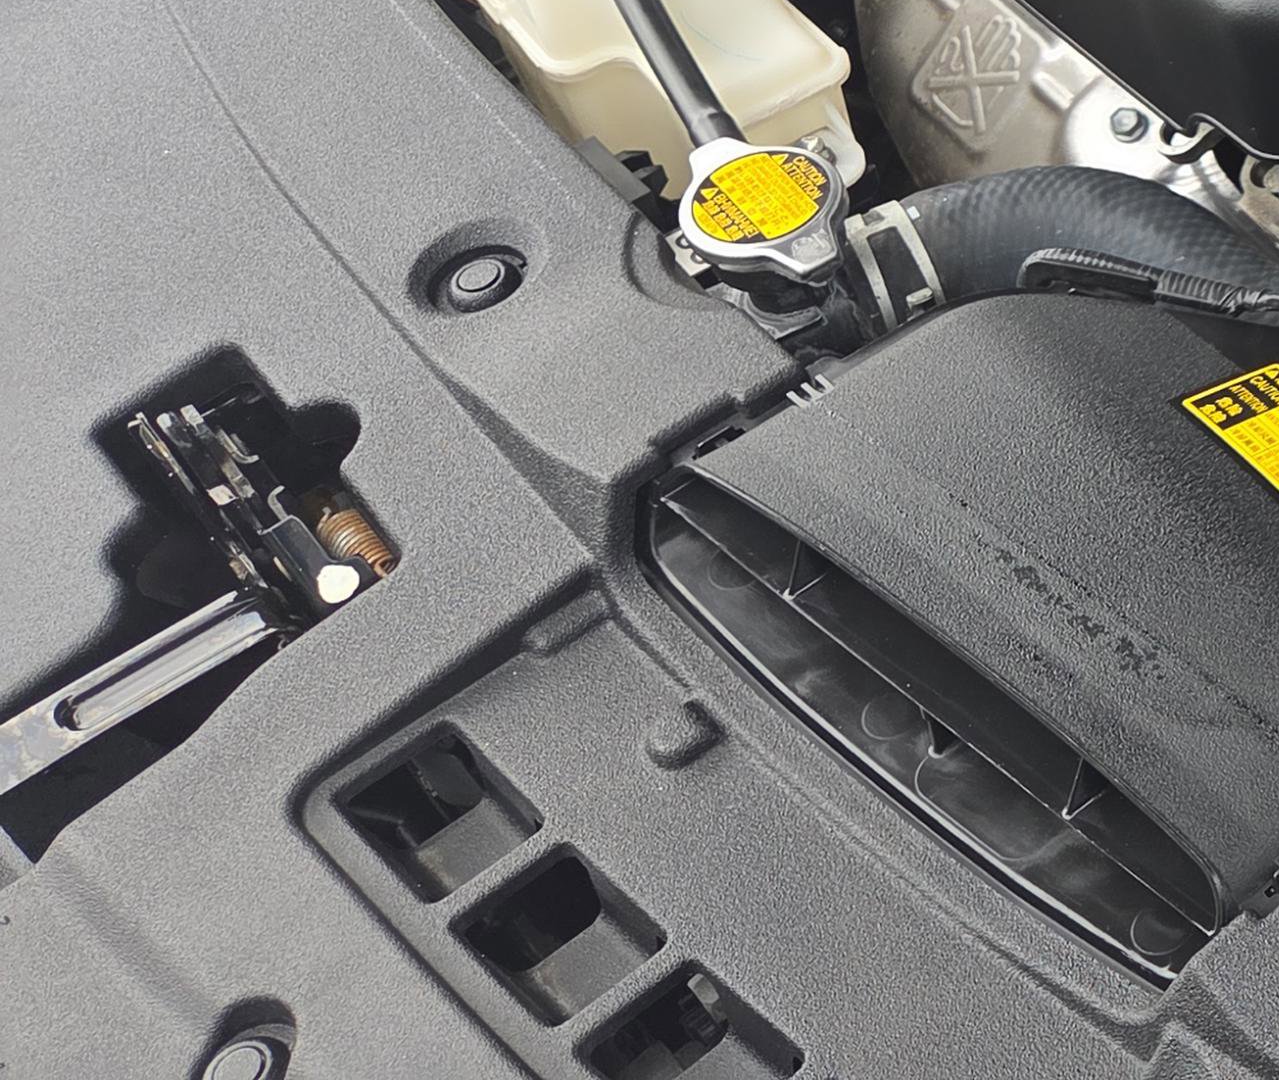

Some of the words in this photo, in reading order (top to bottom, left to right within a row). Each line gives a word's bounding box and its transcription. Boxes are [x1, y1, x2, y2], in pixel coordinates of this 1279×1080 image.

[782, 161, 822, 200] ATTENTION
[793, 154, 827, 187] CAUTION
[1228, 383, 1269, 415] ATTENTION
